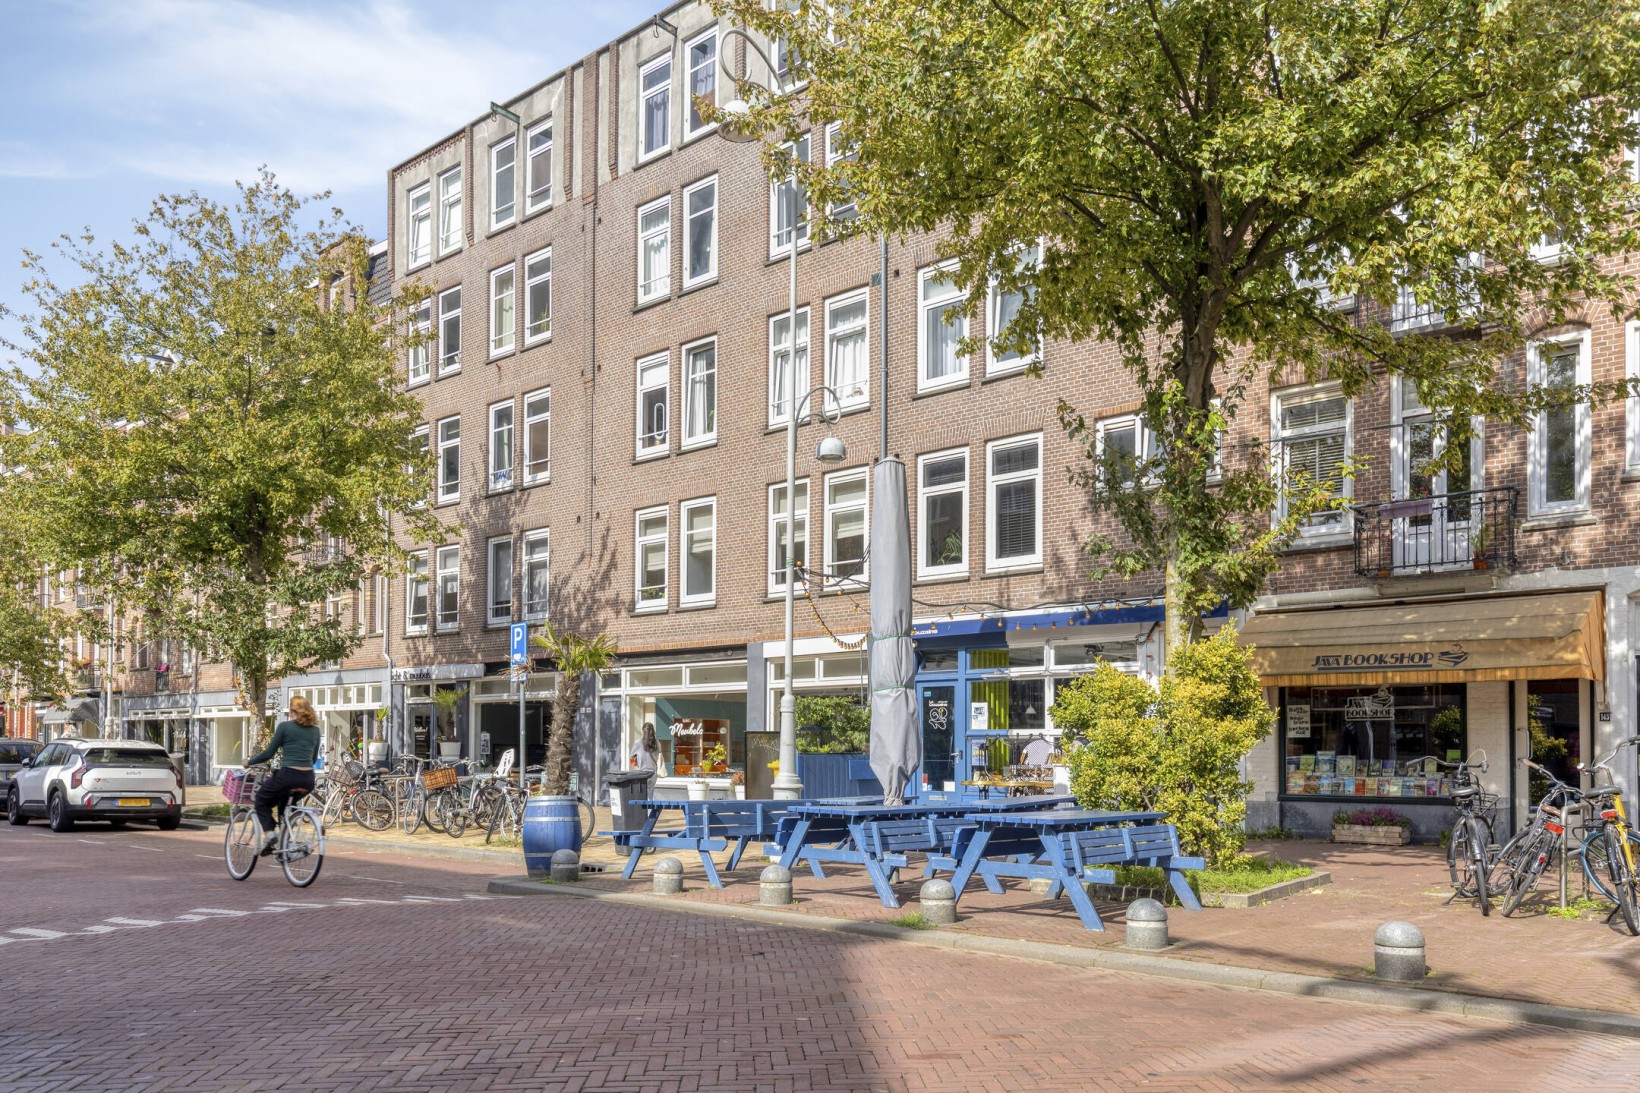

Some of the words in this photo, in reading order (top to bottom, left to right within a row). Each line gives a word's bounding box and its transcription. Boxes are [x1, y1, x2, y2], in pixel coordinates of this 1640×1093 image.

[514, 627, 523, 650] P
[1312, 655, 1342, 667] JAVA
[1343, 653, 1434, 666] BOOKSHOP
[669, 722, 704, 737] Meubels
